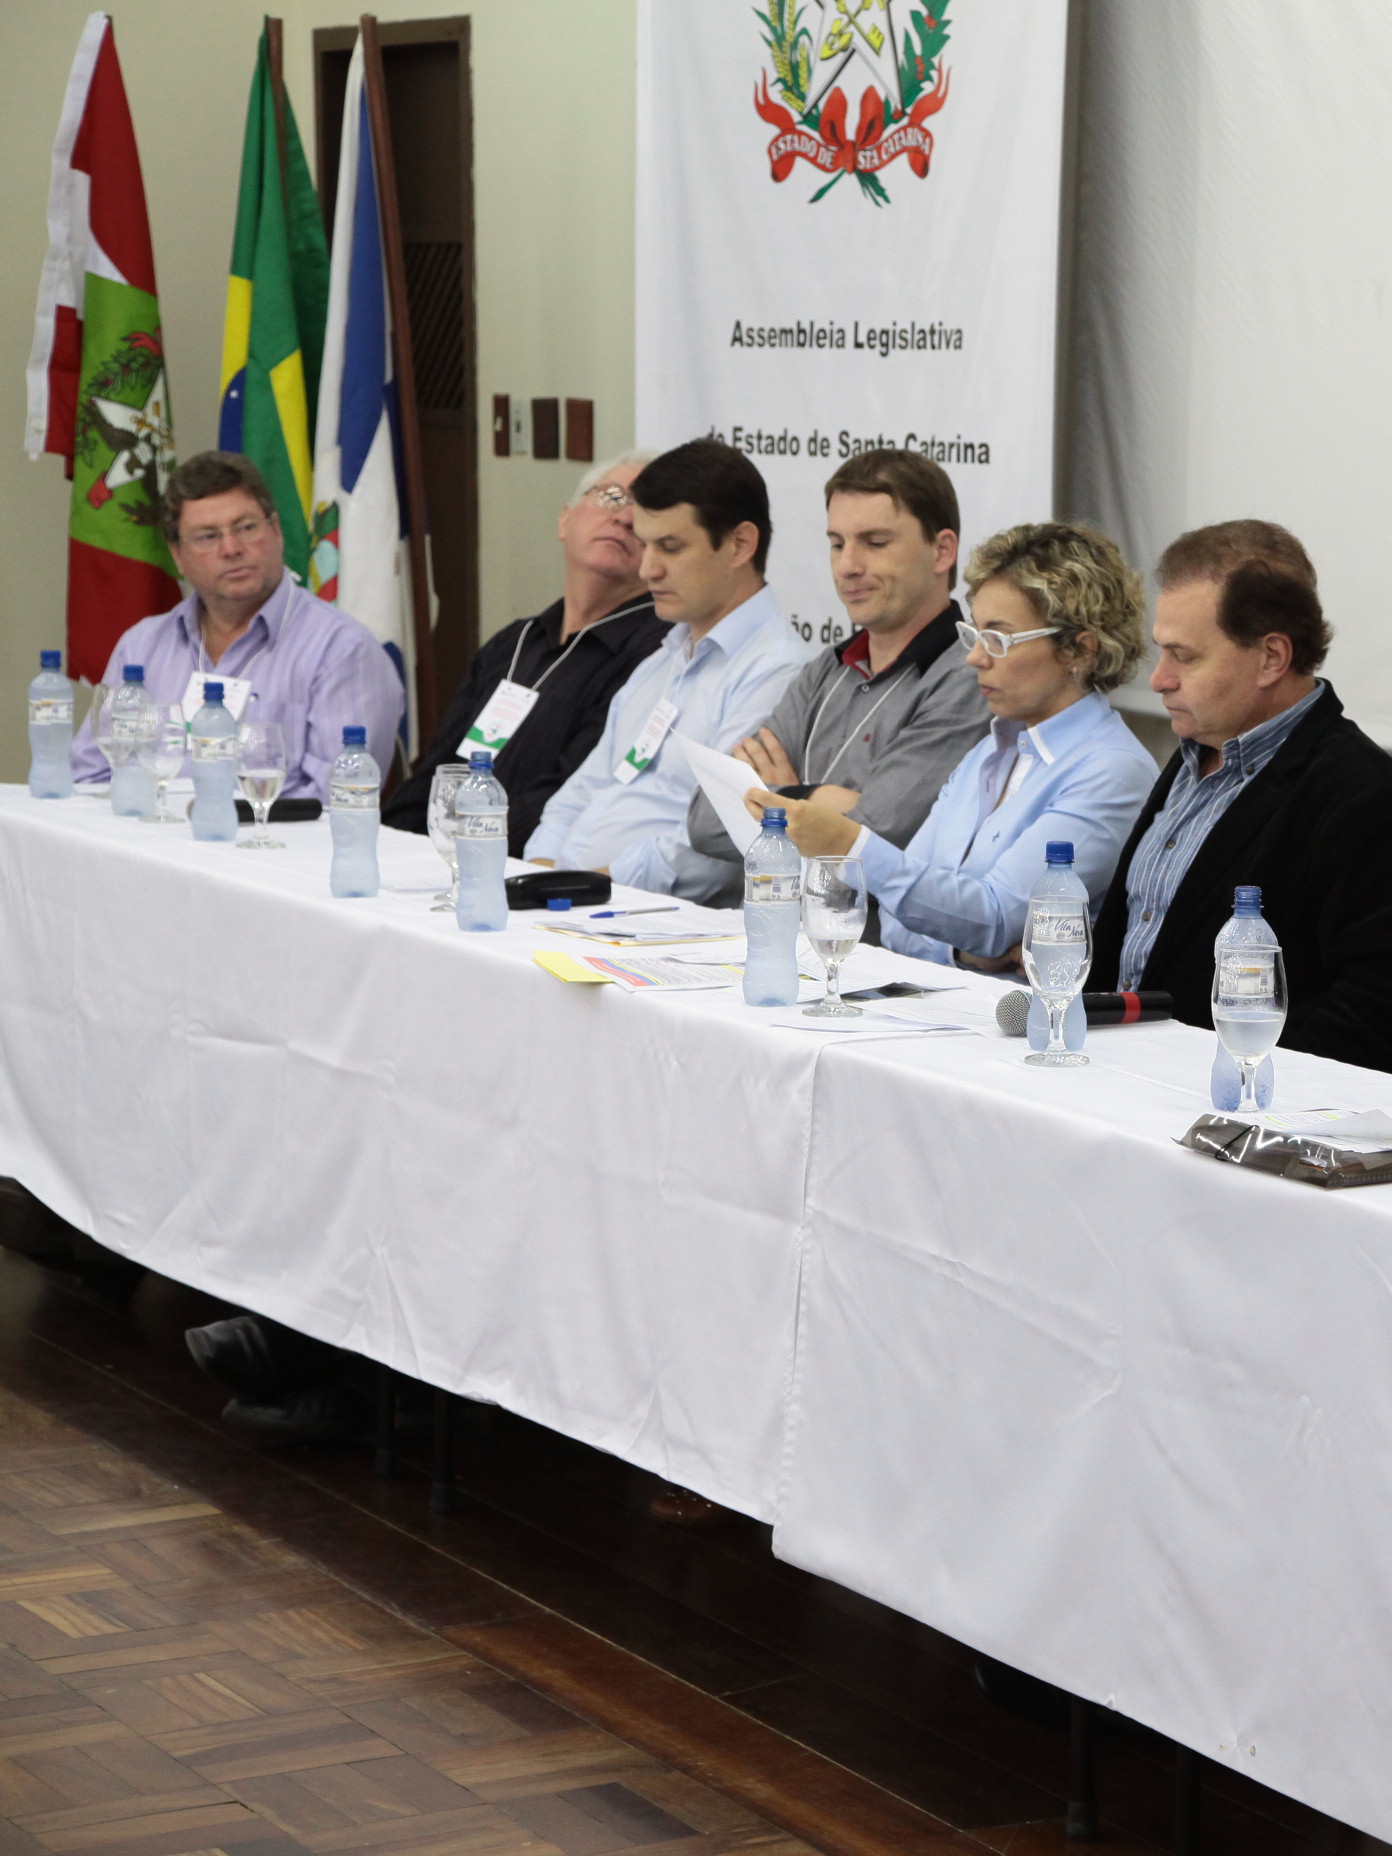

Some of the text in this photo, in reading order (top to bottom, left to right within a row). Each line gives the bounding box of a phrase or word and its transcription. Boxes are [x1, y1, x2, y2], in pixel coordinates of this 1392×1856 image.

[771, 133, 818, 161] ESTADO
[817, 147, 835, 169] DE
[730, 319, 964, 357] Assembleia Legislativa
[732, 425, 801, 456] Estado
[807, 428, 831, 458] de
[904, 431, 991, 464] Catarina
[820, 615, 843, 644] de
